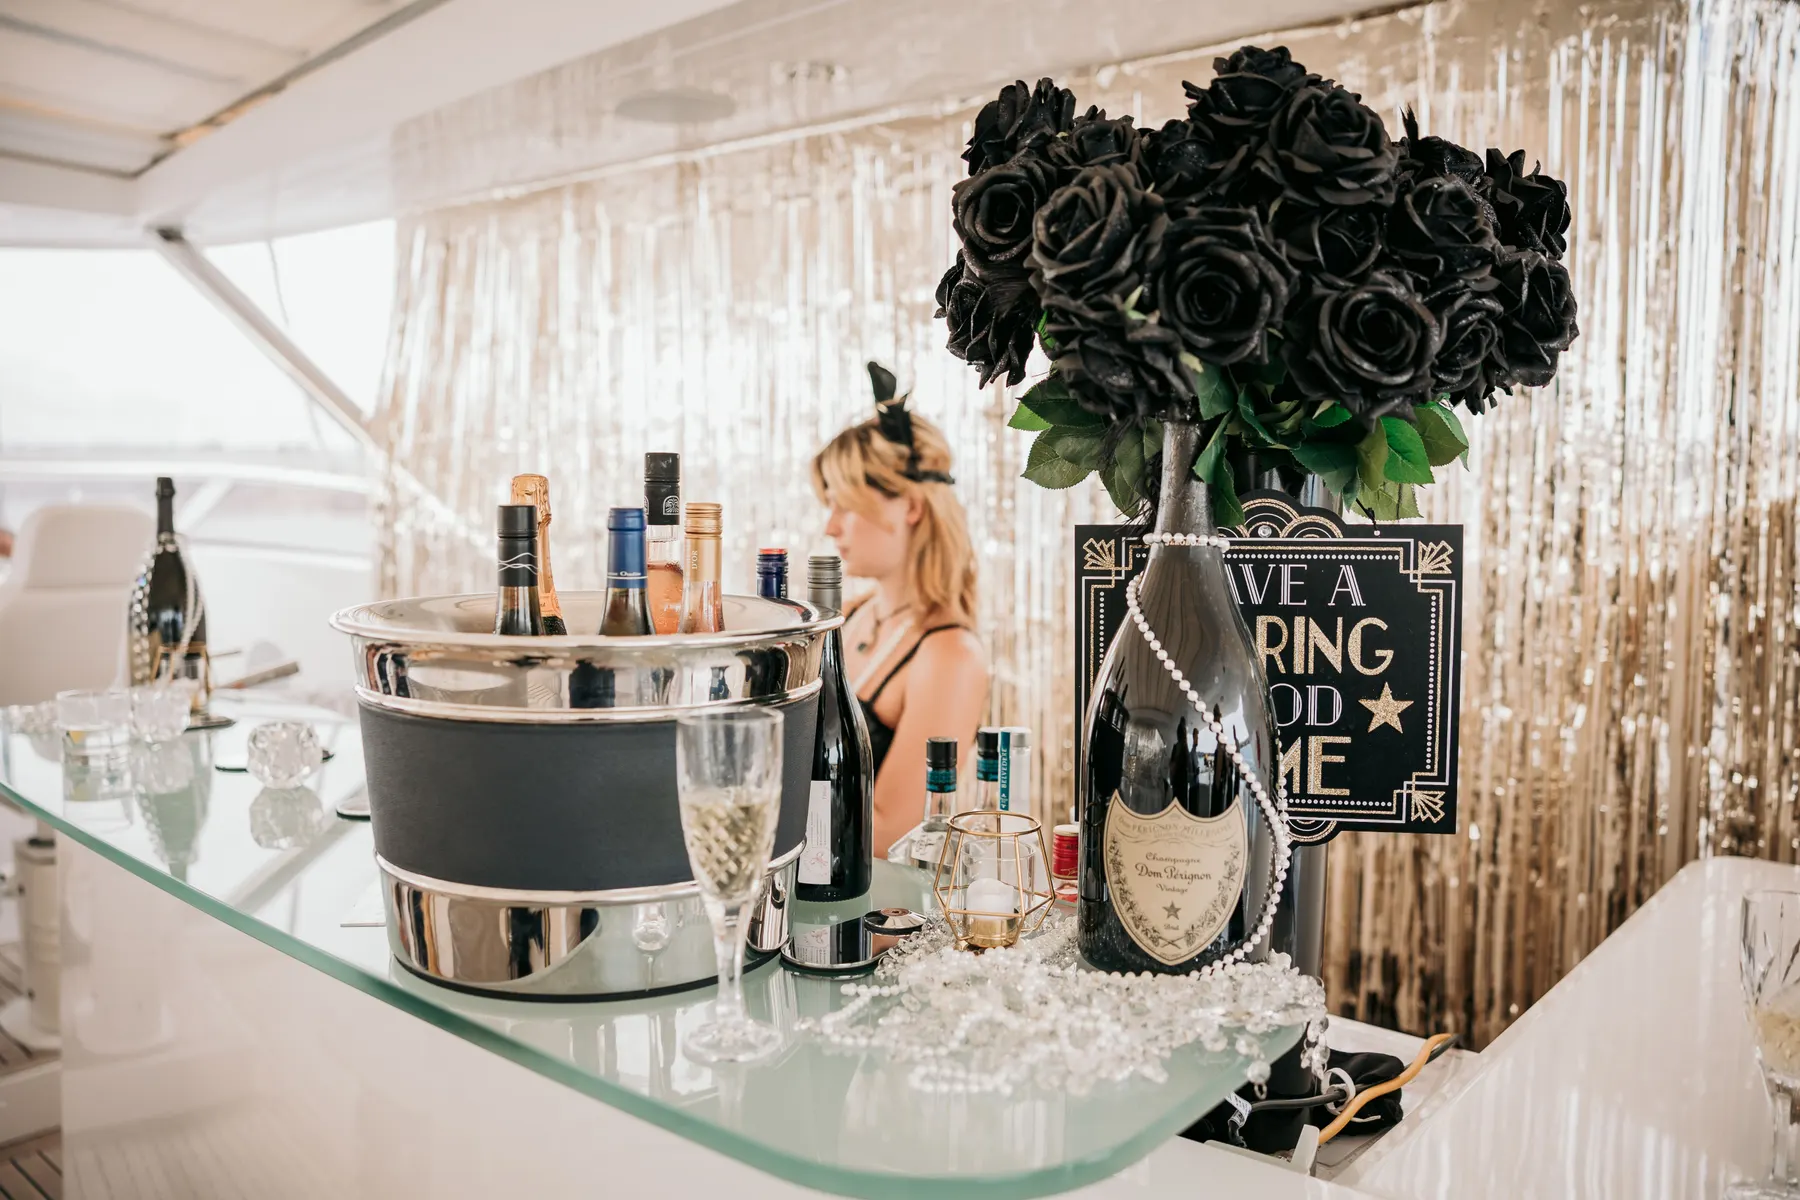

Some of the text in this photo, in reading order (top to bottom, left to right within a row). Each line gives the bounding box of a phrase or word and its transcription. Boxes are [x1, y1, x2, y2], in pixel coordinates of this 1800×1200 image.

[1223, 563, 1367, 607] AVE A
[1255, 615, 1395, 676] RING
[1269, 683, 1343, 728] OD
[1281, 735, 1352, 797] ME
[1134, 862, 1163, 878] Dom
[1145, 852, 1200, 866] Champagne
[1156, 883, 1188, 895] Vintage
